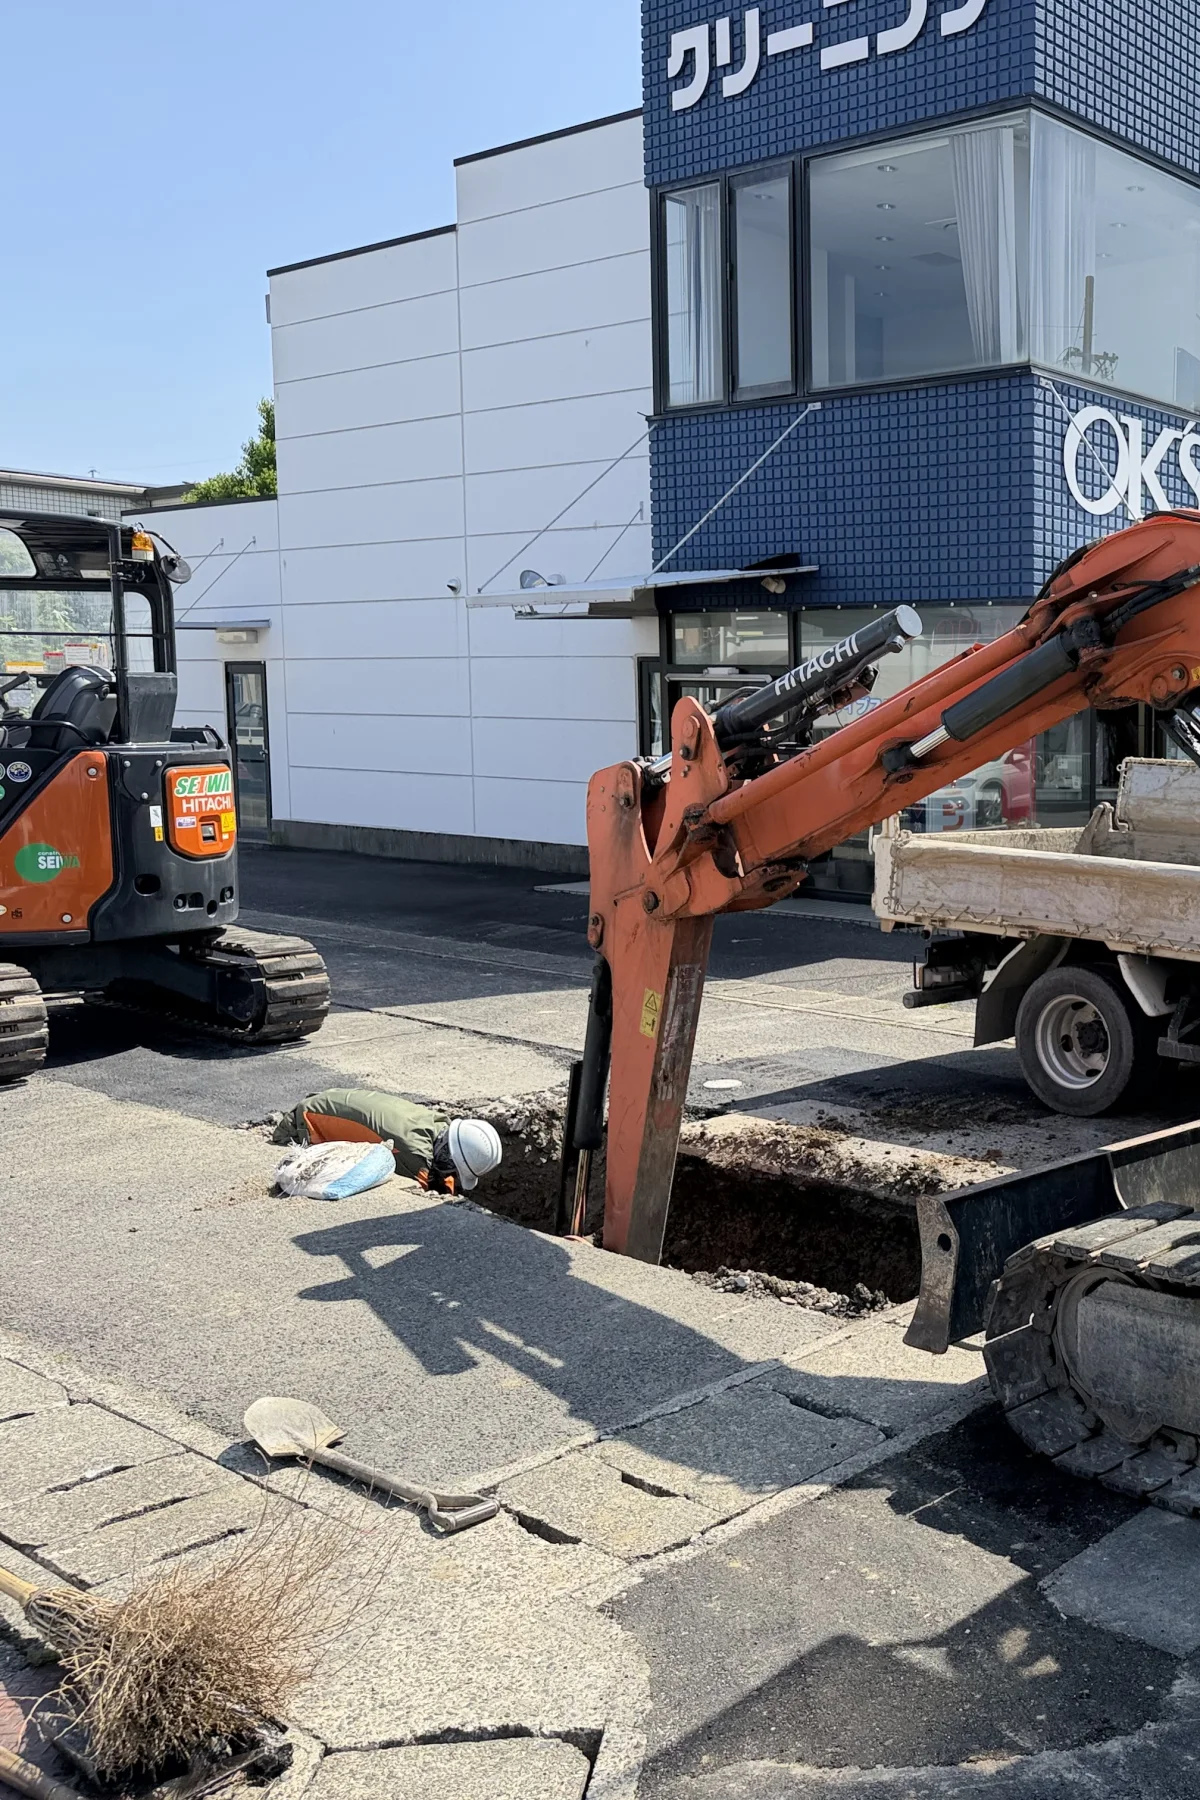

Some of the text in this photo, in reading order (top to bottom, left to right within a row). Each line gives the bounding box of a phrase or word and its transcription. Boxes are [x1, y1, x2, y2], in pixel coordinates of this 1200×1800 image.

[774, 632, 860, 696] HITACHI
[174, 772, 231, 796] SEIWA
[181, 796, 232, 813] HITACHI
[37, 855, 81, 870] SEIWA
